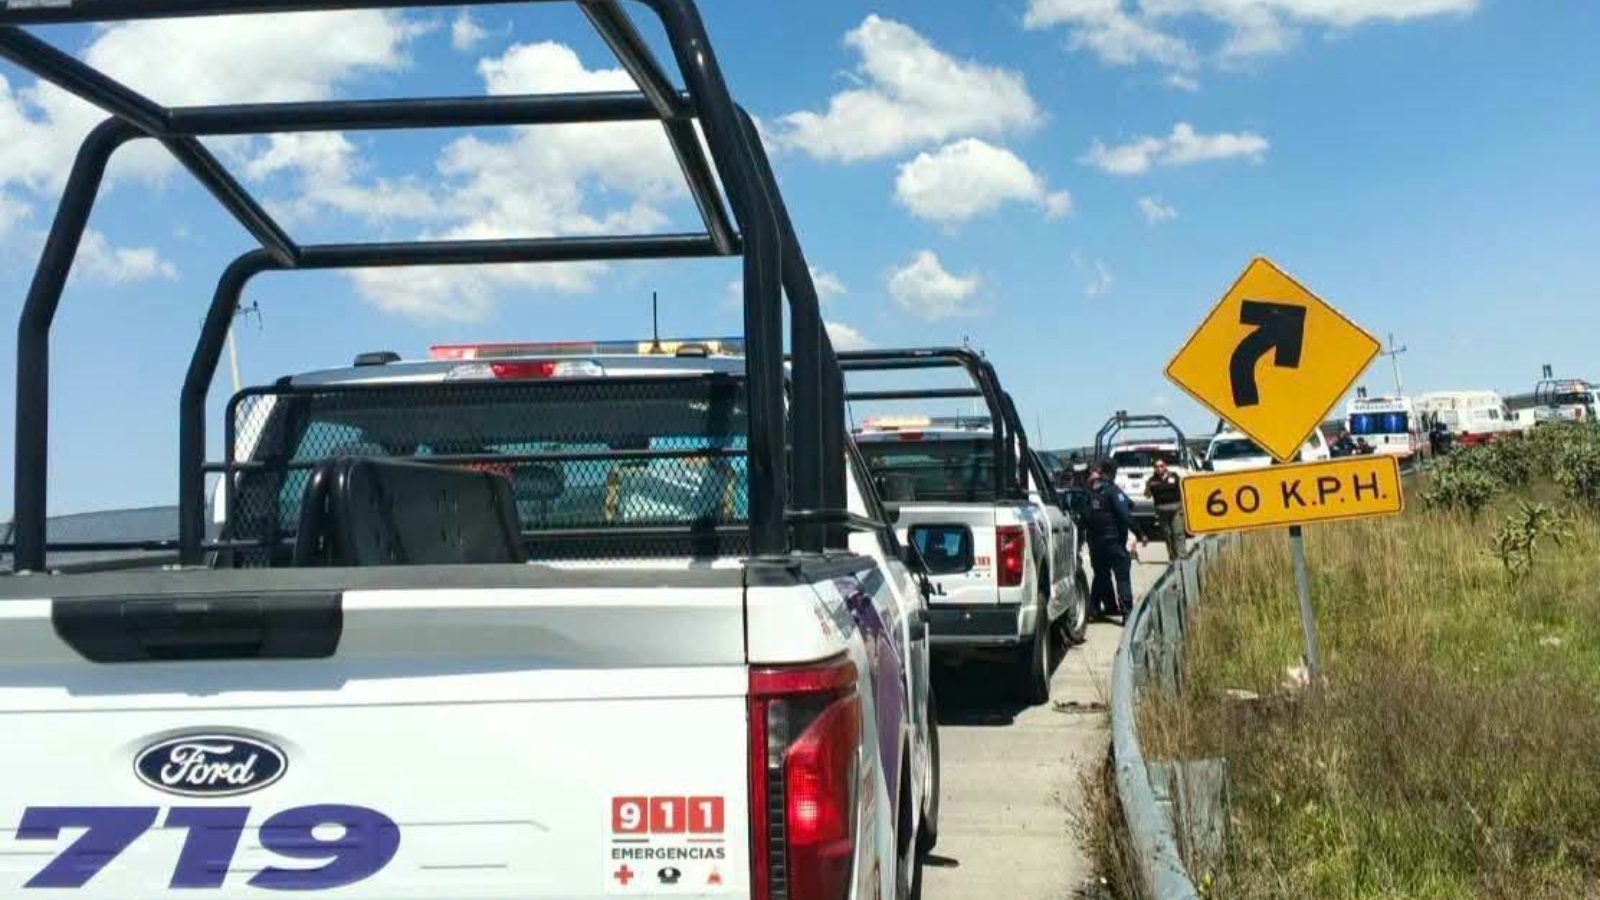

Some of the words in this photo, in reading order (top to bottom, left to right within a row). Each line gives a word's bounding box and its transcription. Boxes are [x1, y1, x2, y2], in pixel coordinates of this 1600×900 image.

[1206, 485, 1260, 517] 60
[1280, 471, 1388, 509] K.P.H.
[160, 743, 255, 785] Ford
[617, 799, 716, 831] 911
[15, 804, 401, 891] 719
[611, 847, 726, 860] EMERGENCIAS
